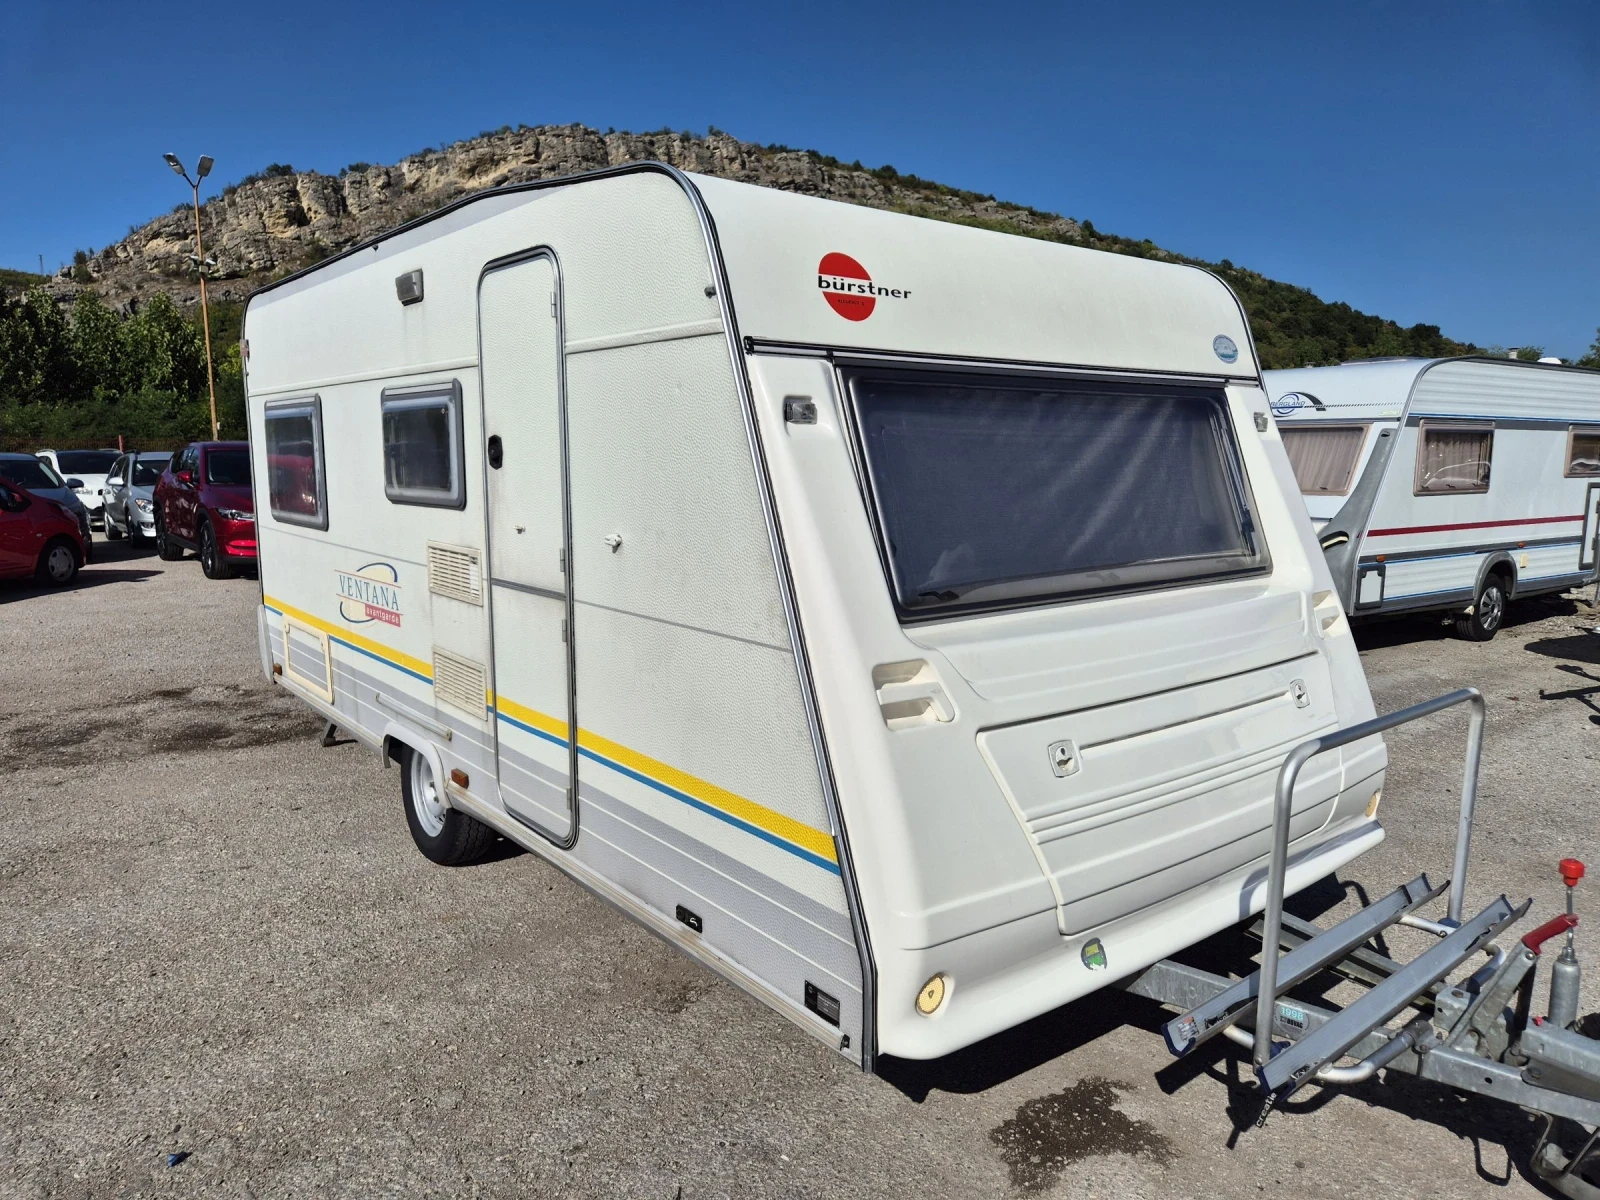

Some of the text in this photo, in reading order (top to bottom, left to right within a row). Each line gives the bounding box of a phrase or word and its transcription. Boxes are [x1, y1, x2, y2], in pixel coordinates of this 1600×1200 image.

[818, 275, 912, 299] bürstner
[339, 574, 400, 612] VENTANA
[366, 606, 400, 624] avantgarde
[1281, 1006, 1304, 1019] 1998
